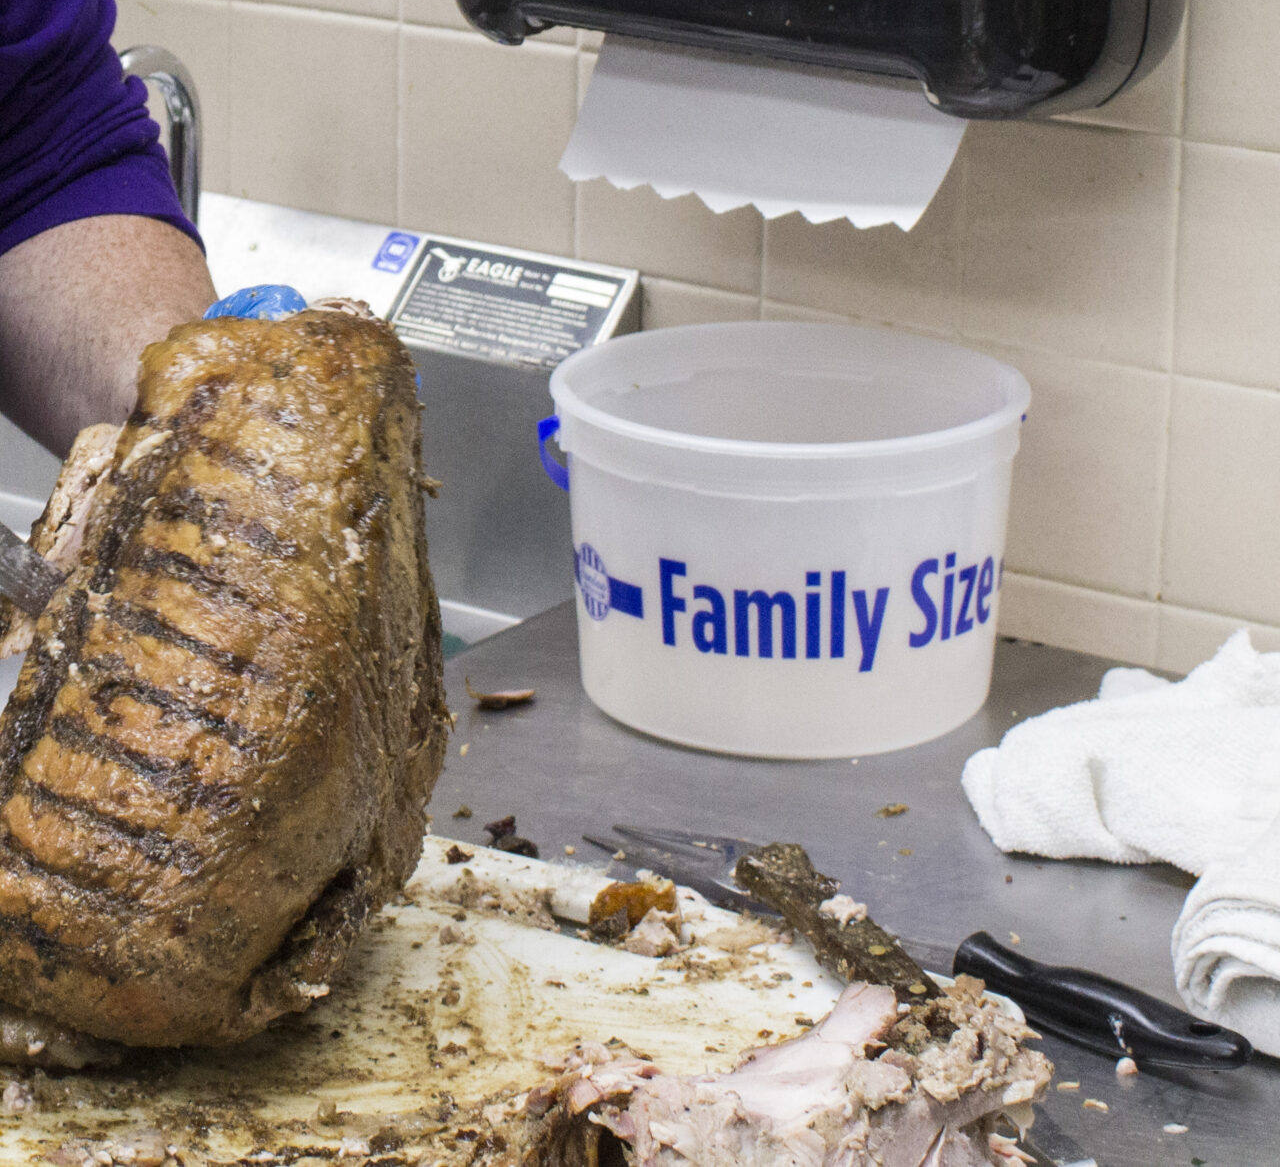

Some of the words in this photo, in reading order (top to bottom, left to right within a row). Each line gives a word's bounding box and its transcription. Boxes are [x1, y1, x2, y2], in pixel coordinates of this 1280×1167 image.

[466, 257, 523, 282] EAGLE
[658, 556, 890, 672] Family
[909, 551, 994, 648] Size
